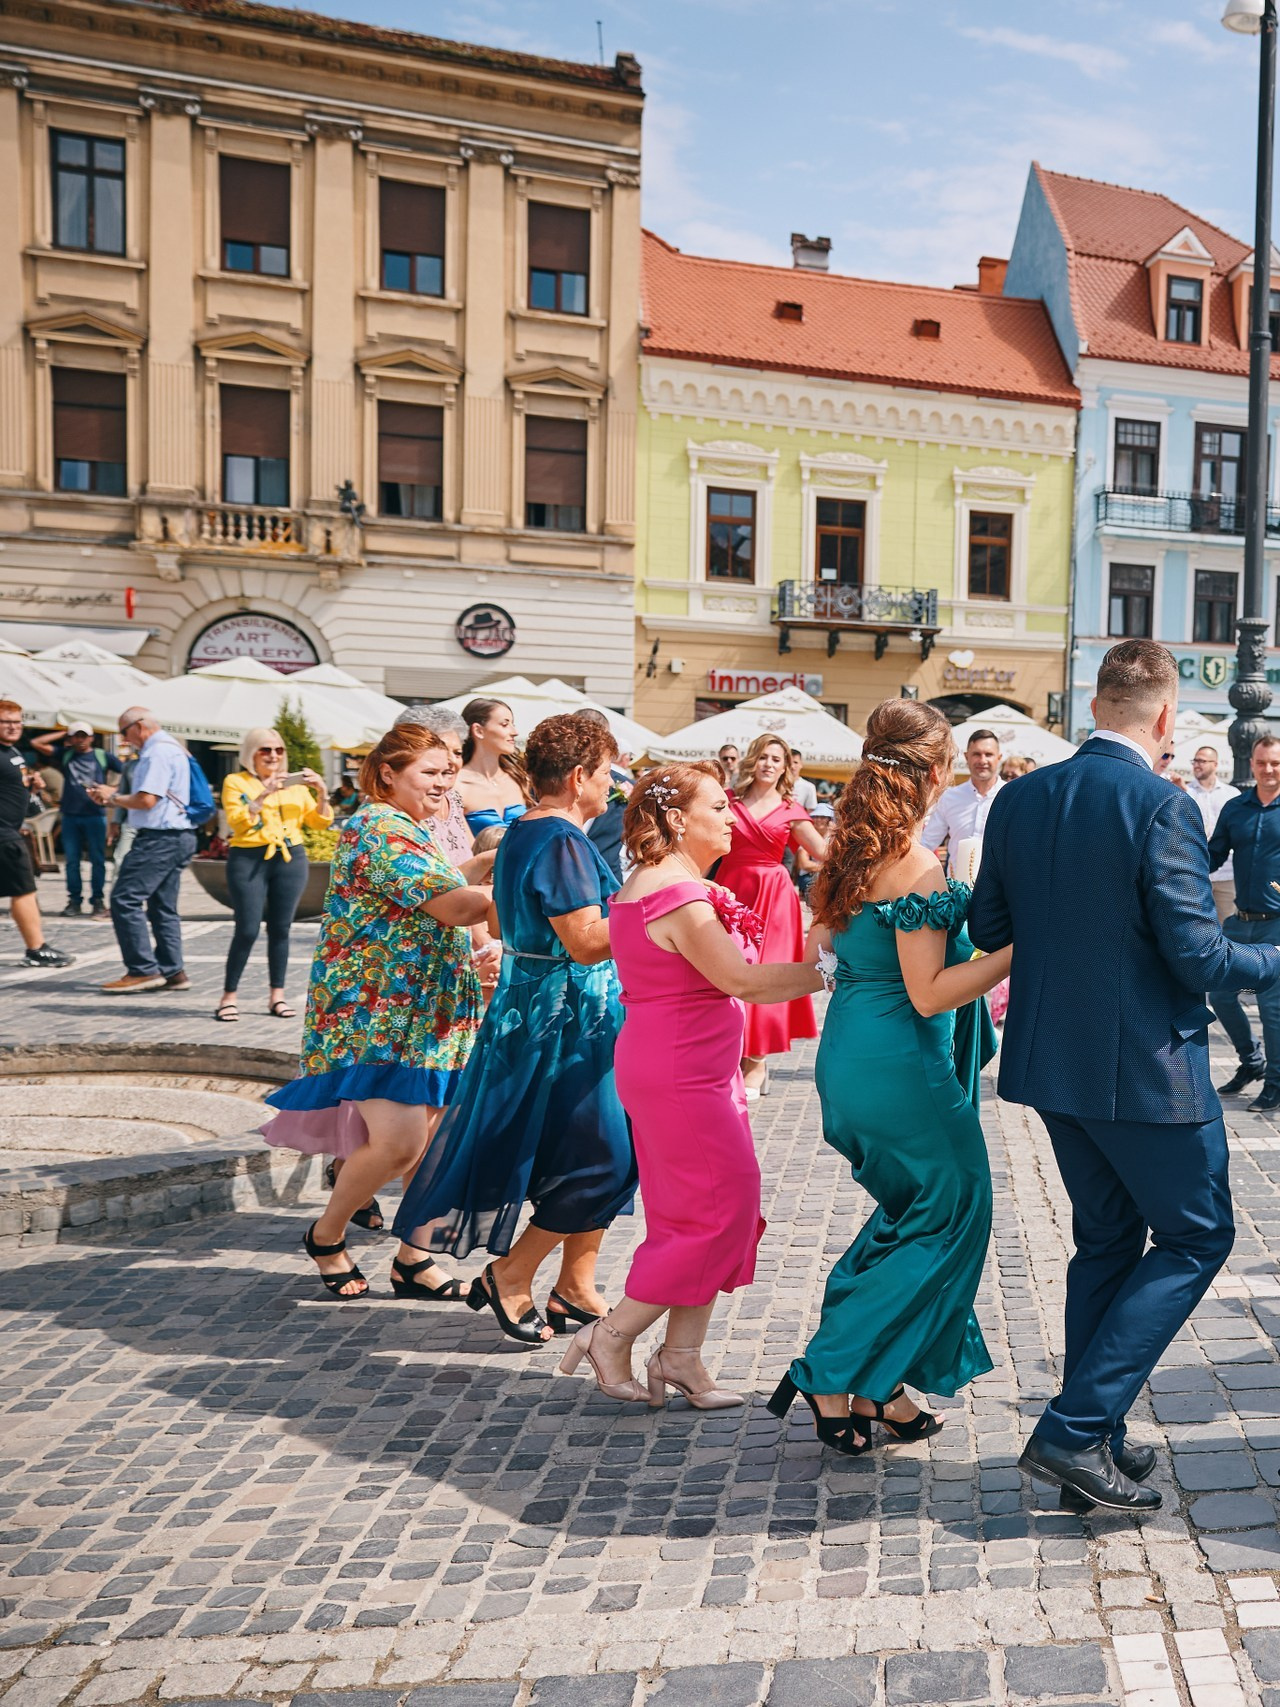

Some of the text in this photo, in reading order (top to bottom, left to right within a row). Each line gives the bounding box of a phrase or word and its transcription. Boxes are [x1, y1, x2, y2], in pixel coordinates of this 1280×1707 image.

[234, 632, 271, 643] ART
[203, 646, 303, 658] GALLERY
[161, 725, 190, 733] TELLA
